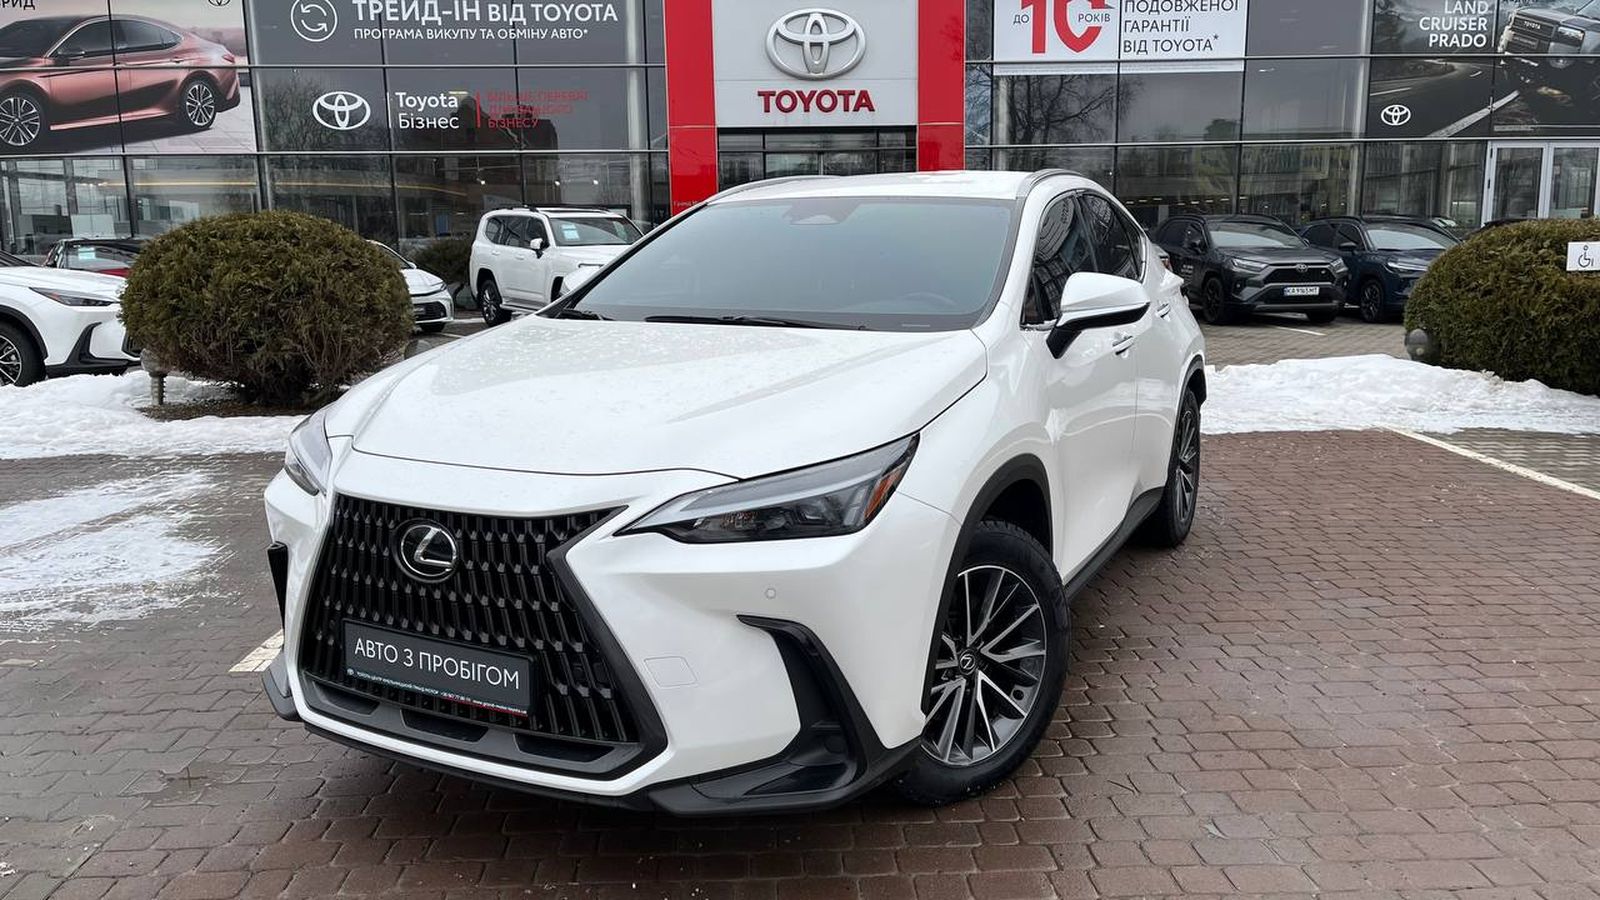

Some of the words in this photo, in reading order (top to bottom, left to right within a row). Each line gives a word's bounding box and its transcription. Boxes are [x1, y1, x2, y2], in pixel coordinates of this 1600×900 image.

[0, 0, 36, 10] РИД
[1444, 0, 1489, 14] LAND
[487, 3, 527, 25] ВІД
[530, 3, 618, 21] TOYOTA
[1013, 14, 1030, 24] ДО
[1078, 13, 1111, 22] РОКІВ
[1124, 15, 1191, 32] ГАРАНТІЇ
[1419, 16, 1488, 31] CRUISER
[354, 28, 424, 39] ПРОГРАМА
[426, 28, 478, 39] ВИКУПУ
[480, 28, 495, 39] ТА
[497, 28, 548, 39] ОБМІНУ
[1429, 33, 1488, 48] PRADO
[1123, 40, 1148, 55] ВІД
[395, 91, 458, 111] Toyota
[757, 89, 875, 114] TOYOTA
[398, 113, 460, 129] Бізнес
[355, 637, 399, 664] АВТО
[419, 652, 519, 690] ПРОБІГОМ
